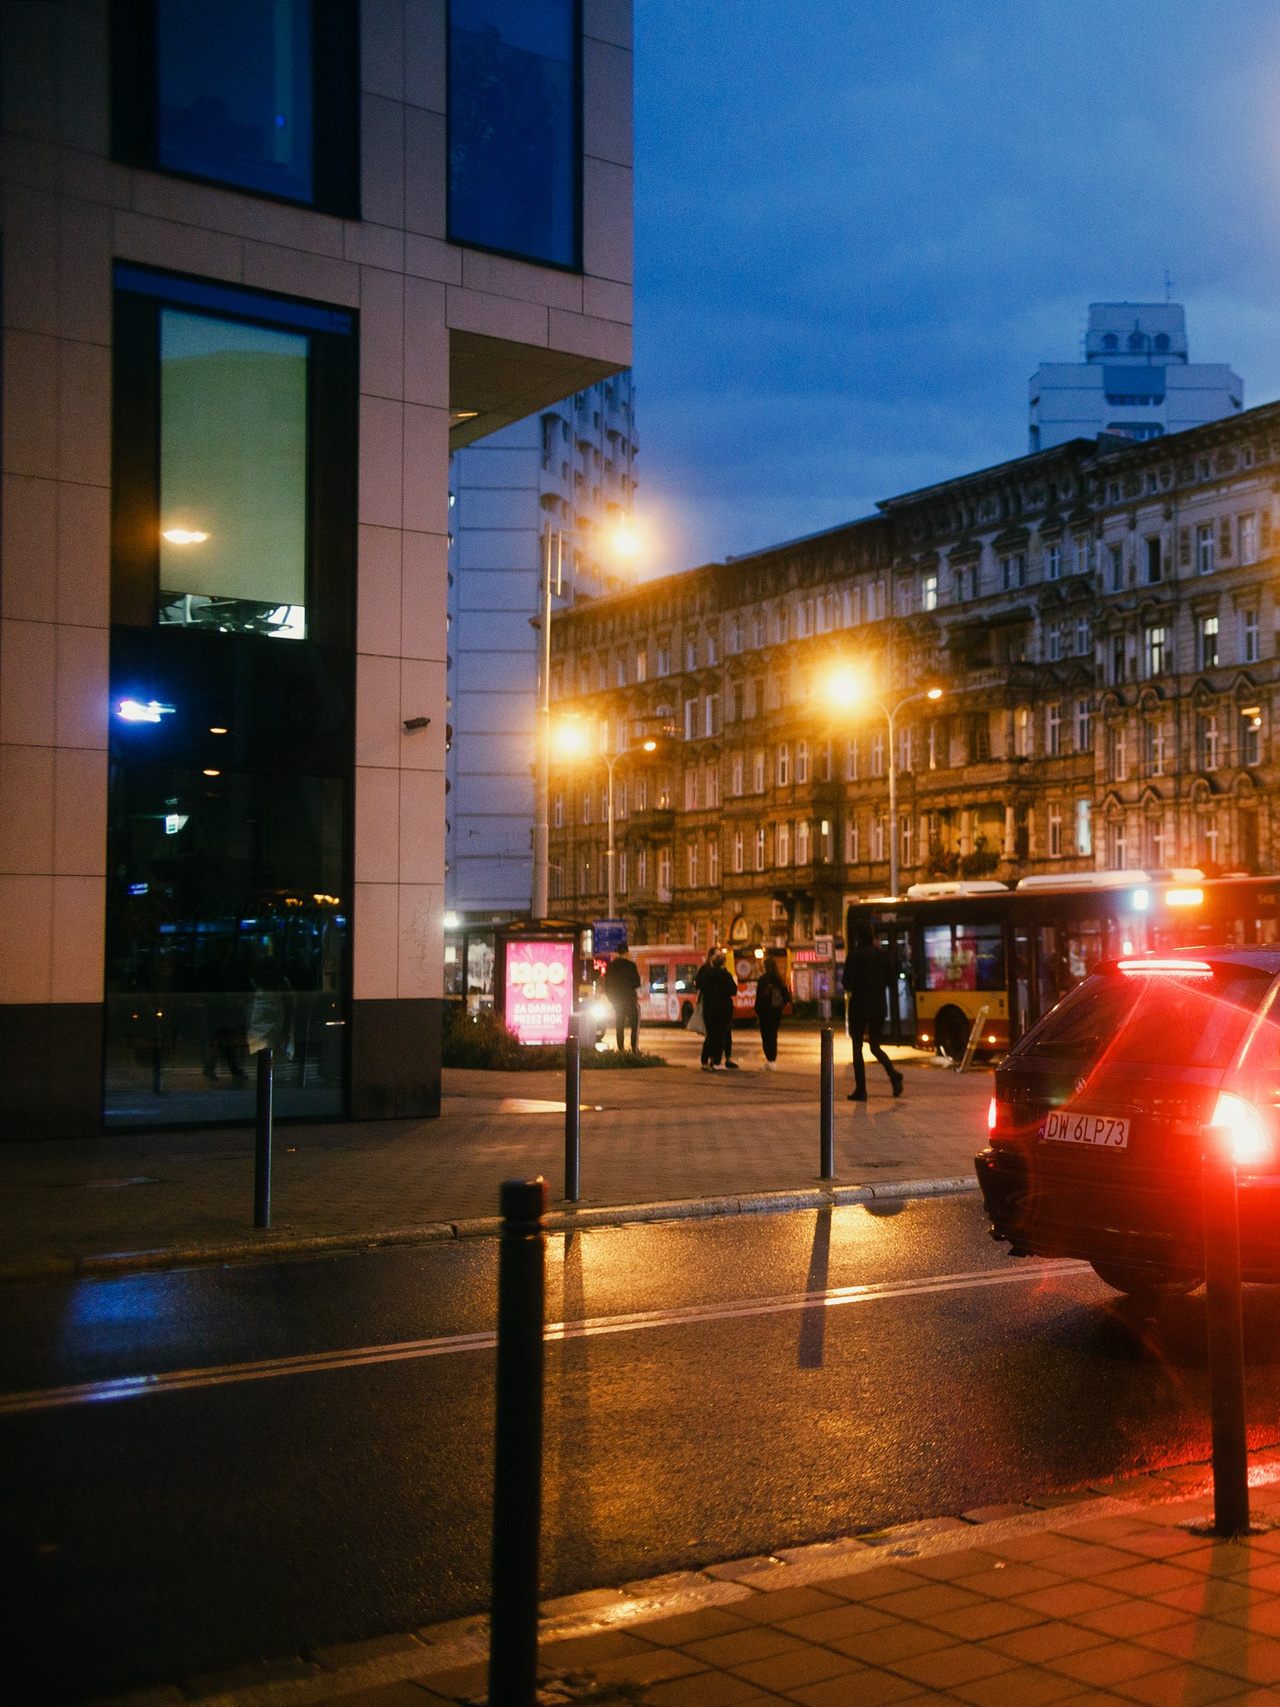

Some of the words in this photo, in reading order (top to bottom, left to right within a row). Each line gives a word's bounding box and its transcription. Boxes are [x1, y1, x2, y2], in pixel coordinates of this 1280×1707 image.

[509, 961, 565, 984] 1200
[514, 1003, 527, 1014] ZA
[528, 1003, 562, 1014] DARMO
[513, 1013, 542, 1024] PRZEZ
[543, 1013, 562, 1024] ROK
[1047, 1113, 1069, 1139] DW
[1073, 1116, 1125, 1146] 6LP73
